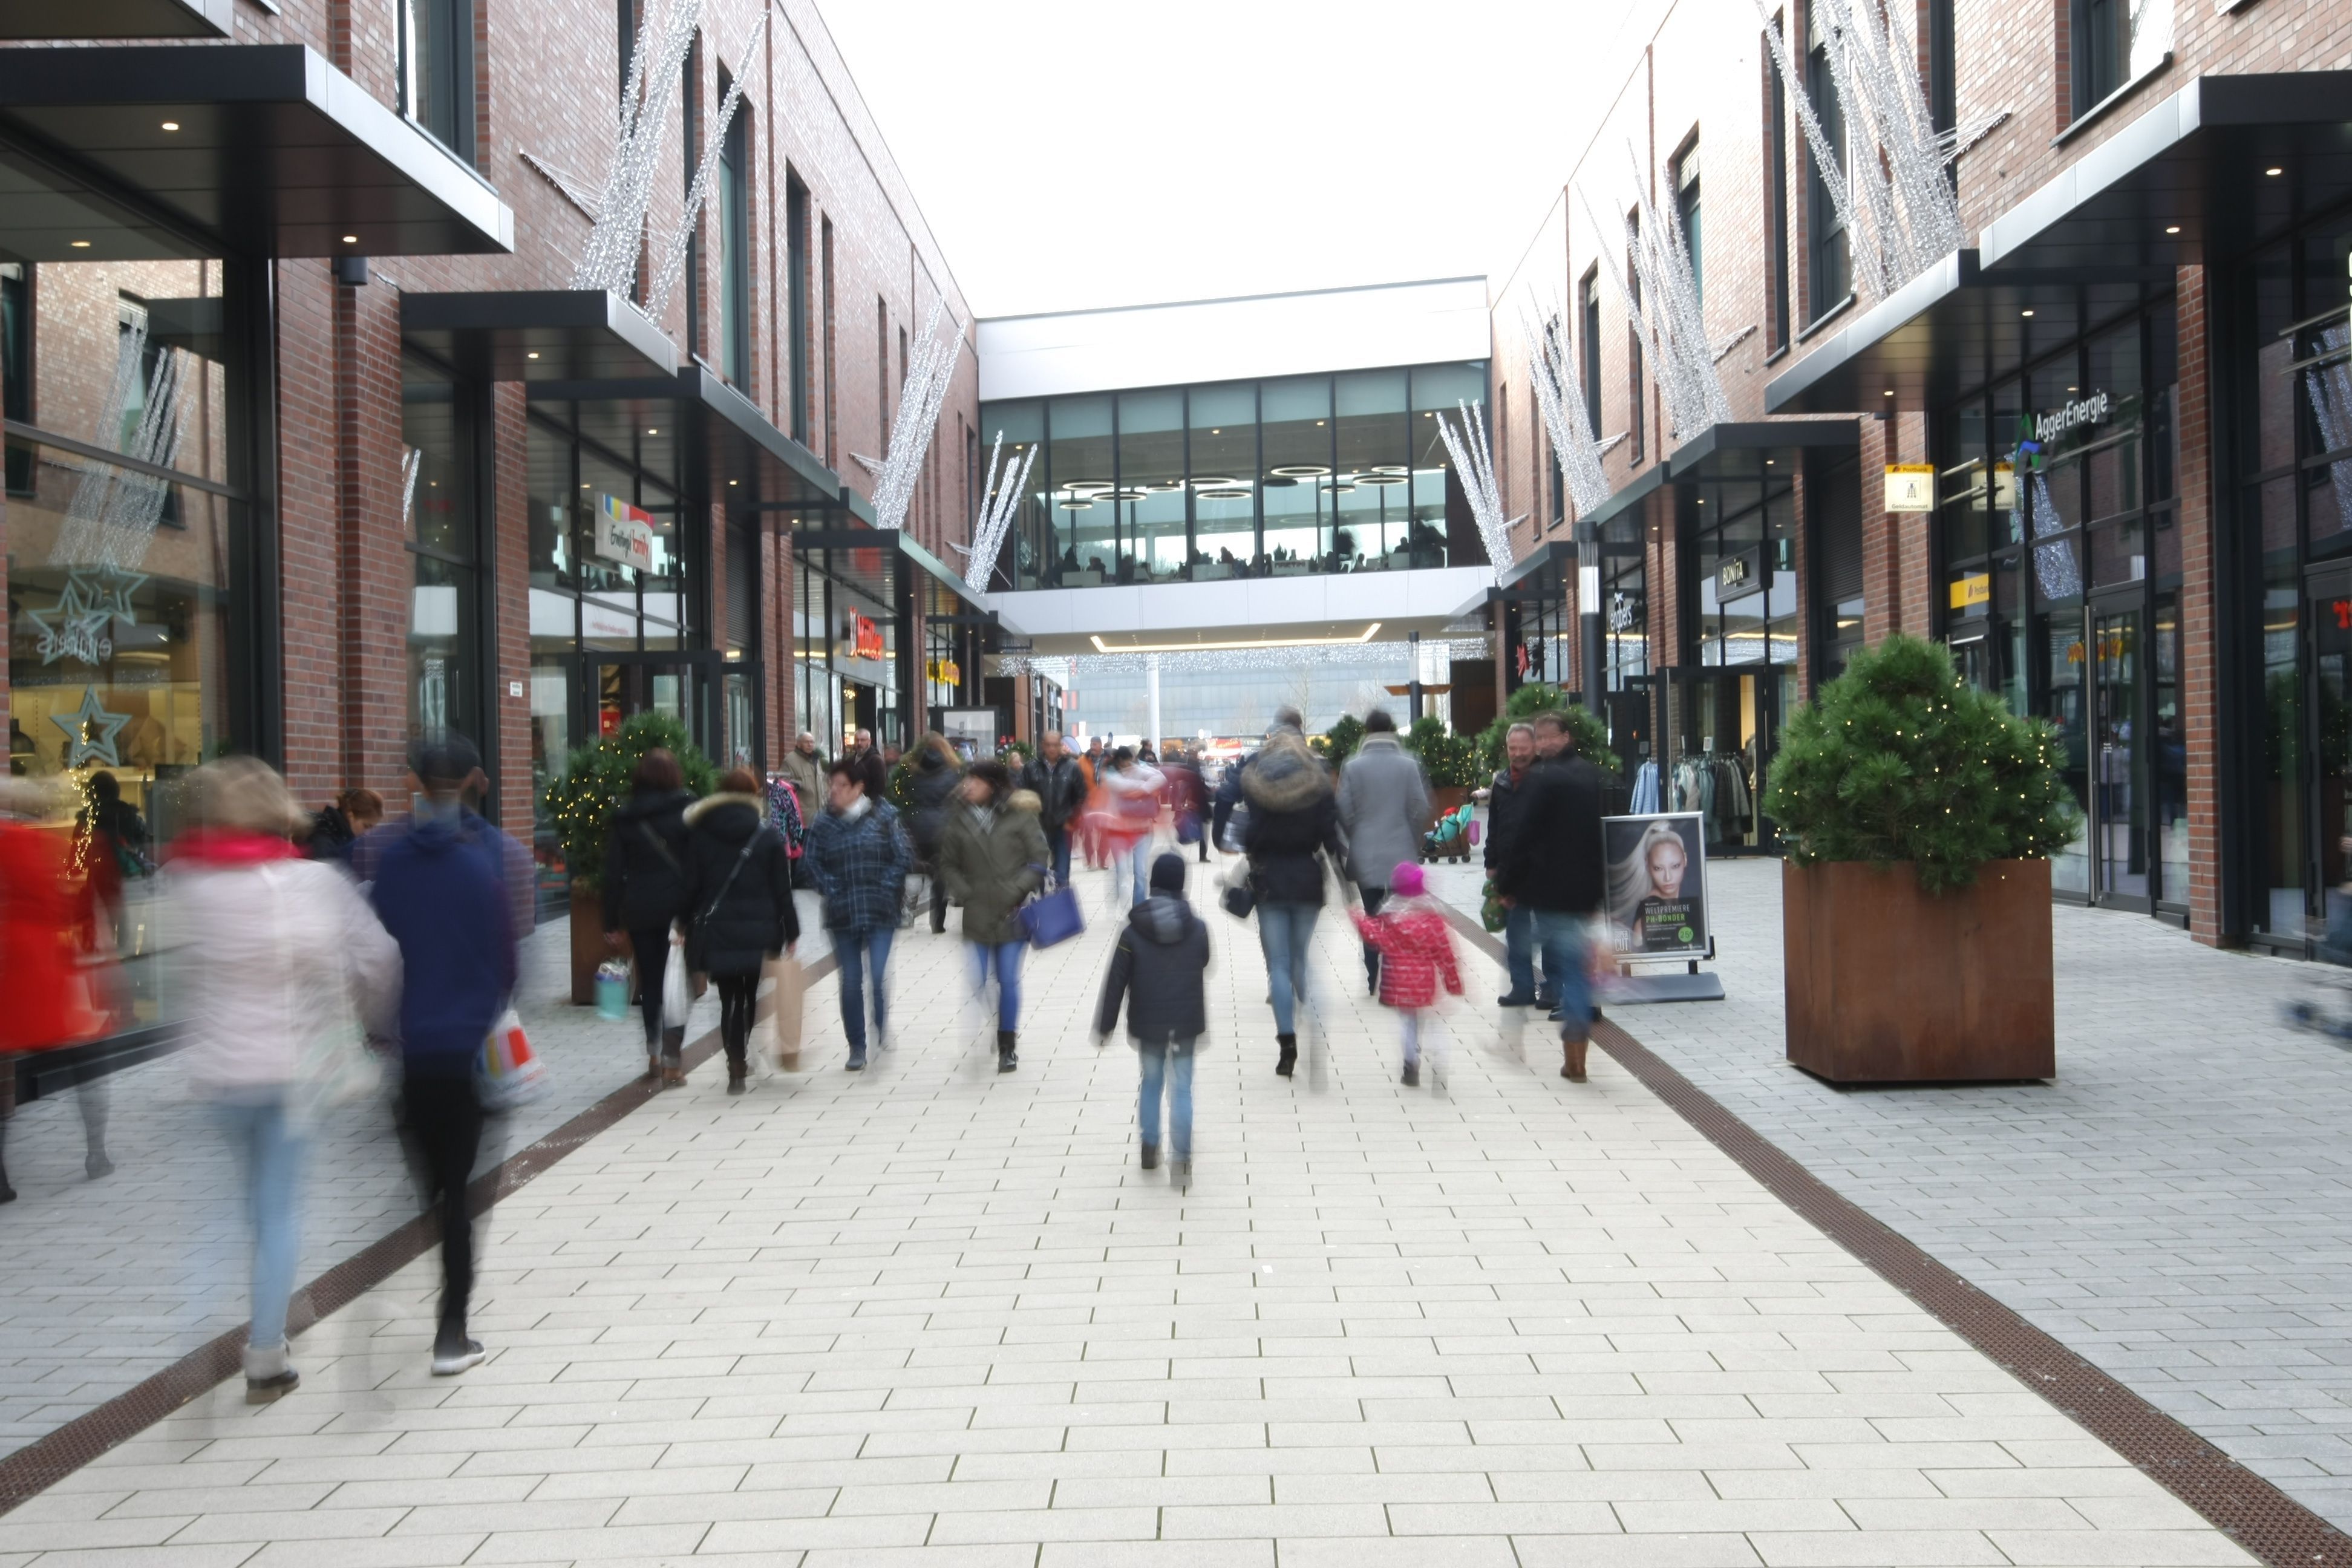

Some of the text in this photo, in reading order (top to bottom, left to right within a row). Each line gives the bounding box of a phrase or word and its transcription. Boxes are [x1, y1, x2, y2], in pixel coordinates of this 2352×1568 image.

[2035, 388, 2108, 443] AggerEnergie
[1722, 558, 1743, 587] BONITA
[1610, 603, 1632, 635] engbers
[1645, 904, 1690, 915] WELTPREMIERE
[1645, 913, 1685, 923] PH-BONDER
[1615, 938, 1629, 952] CUT
